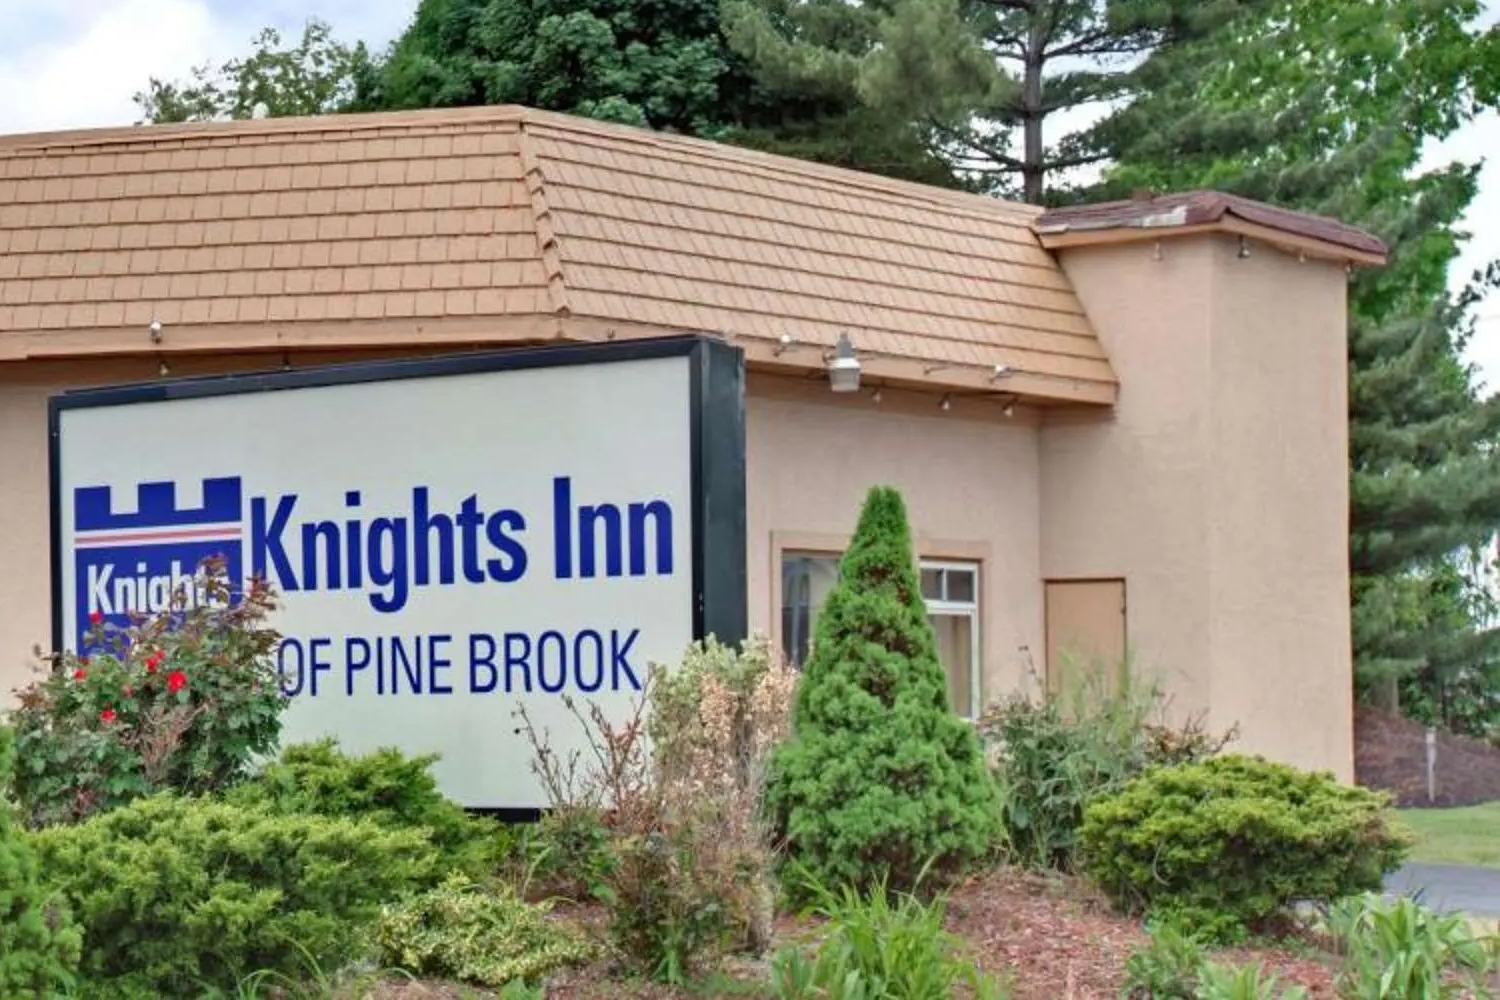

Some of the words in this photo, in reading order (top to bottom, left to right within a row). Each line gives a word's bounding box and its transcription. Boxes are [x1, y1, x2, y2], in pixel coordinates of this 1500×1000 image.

[250, 485, 528, 614] Knights
[553, 476, 674, 580] Inn
[278, 637, 332, 698] OF
[345, 634, 453, 695] PINE
[469, 629, 642, 693] BROOK
